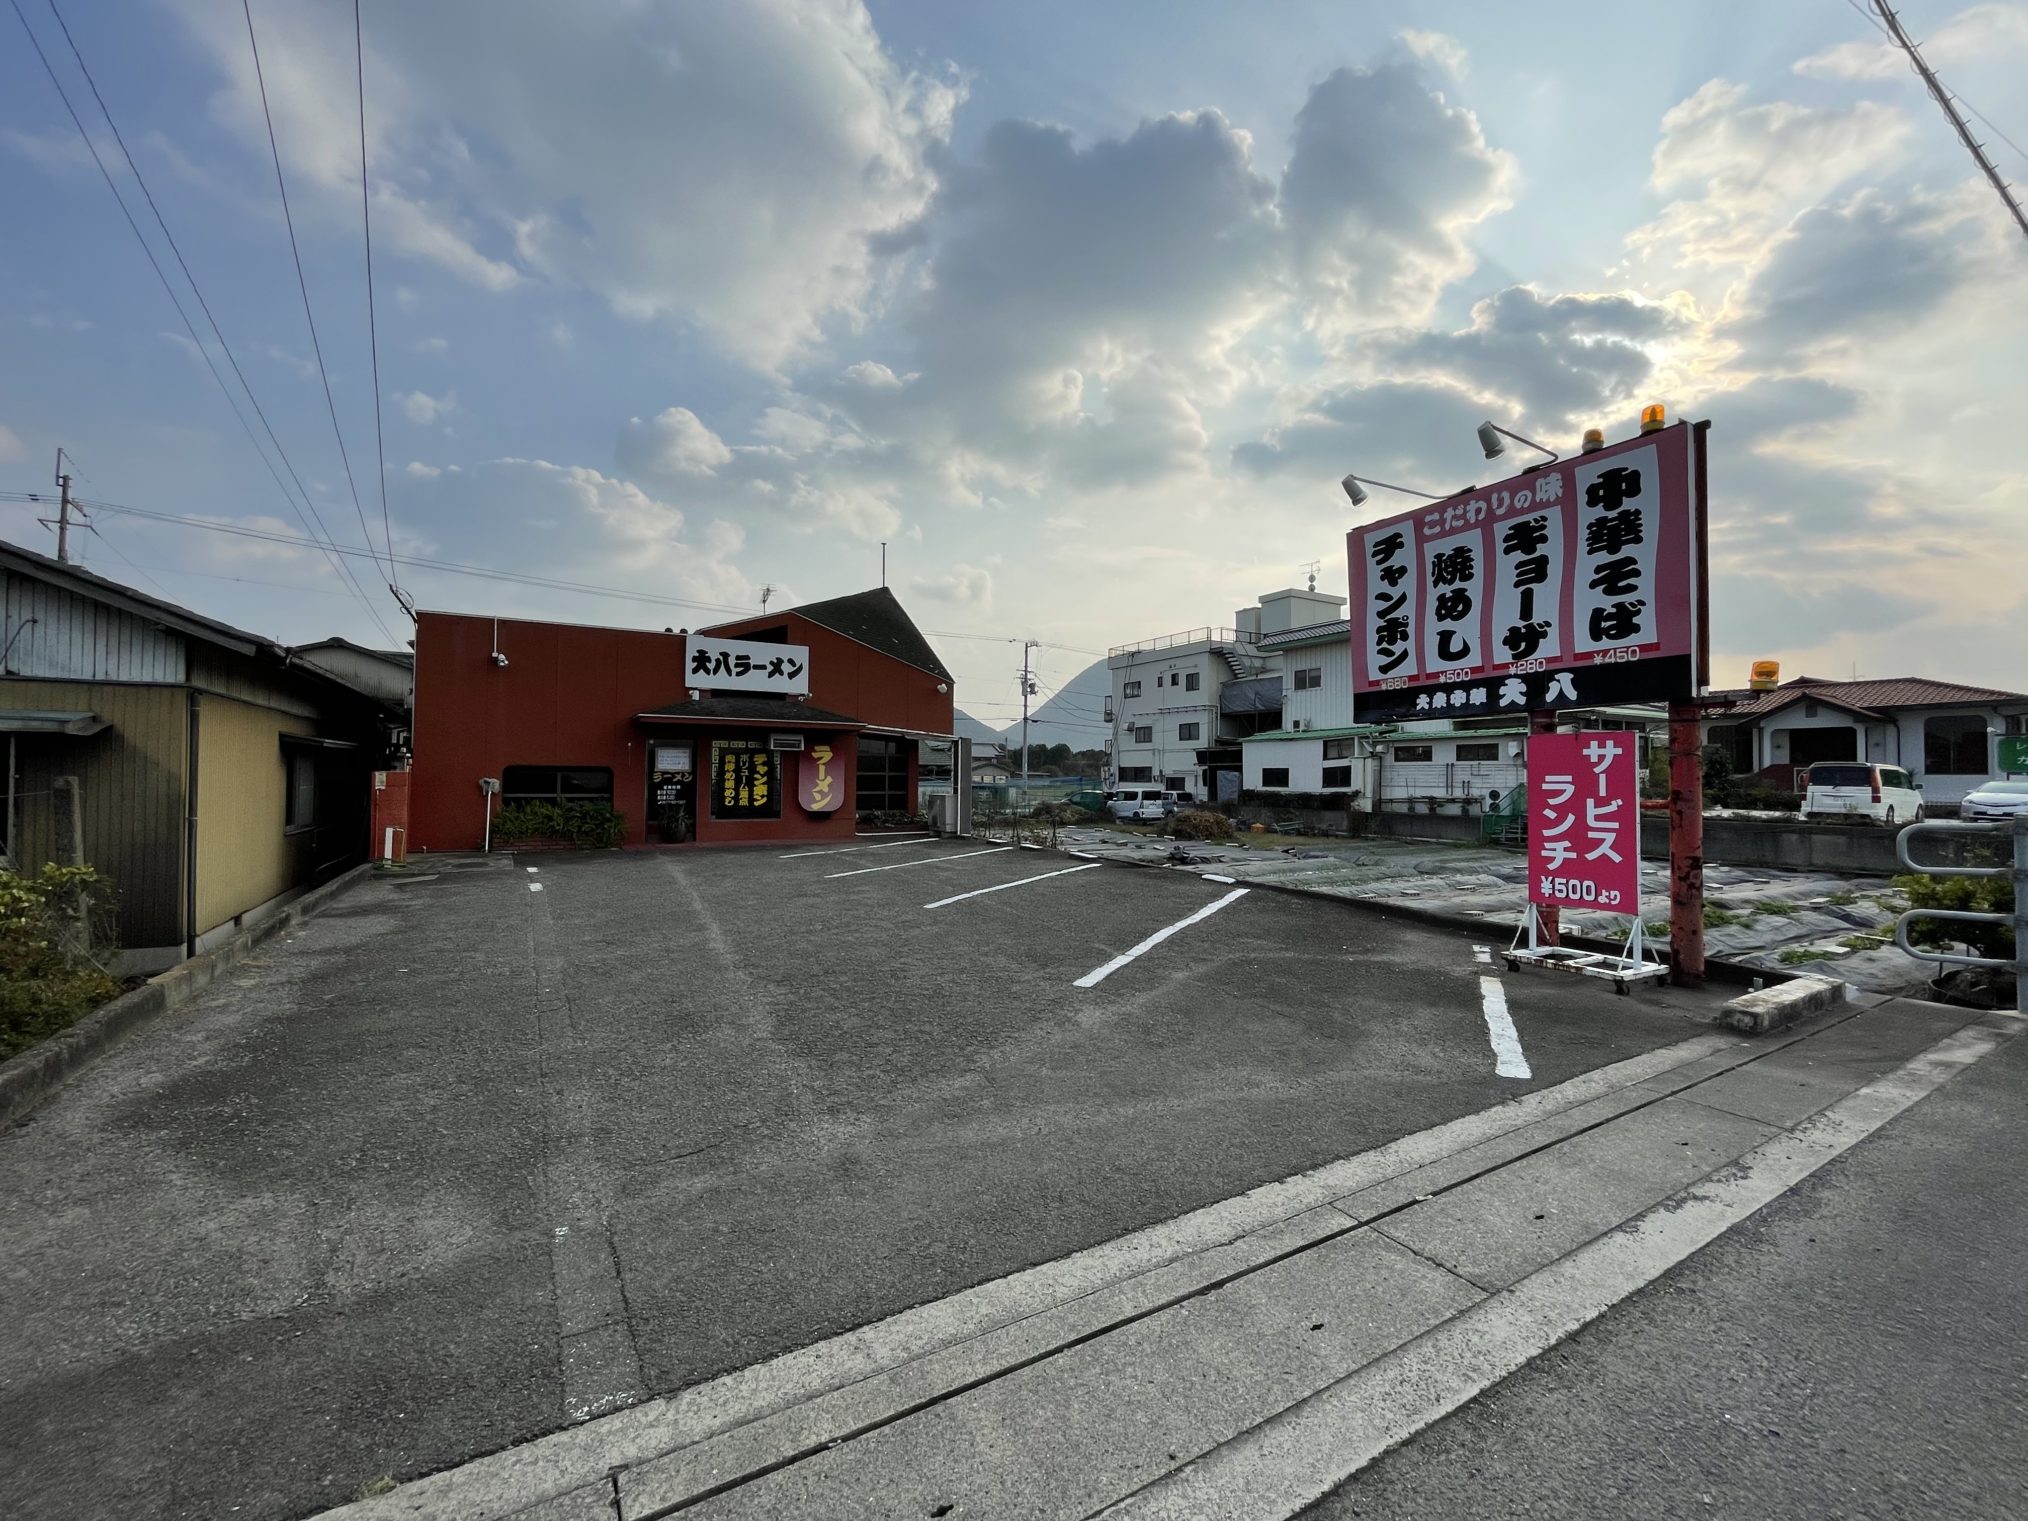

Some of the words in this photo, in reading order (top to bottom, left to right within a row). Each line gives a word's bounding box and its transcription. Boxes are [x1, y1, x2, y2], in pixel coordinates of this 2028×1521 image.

[1423, 472, 1564, 535] こだわりの味
[1584, 466, 1647, 643] 中華そば
[1371, 532, 1409, 675] チャンポン
[1431, 545, 1475, 662] 焼めし
[1502, 515, 1552, 661] ギョーザ
[692, 649, 804, 680] 大八ラーメン
[1380, 676, 1409, 691] ¥680
[1439, 668, 1471, 684] ¥500
[1508, 658, 1547, 675] ¥280
[1593, 646, 1640, 665] ¥450
[1499, 672, 1578, 706] 大八
[653, 772, 693, 782] ラーメン
[753, 753, 768, 807] チャンポン
[811, 745, 833, 811] ラーメン
[1582, 740, 1623, 864] サービス
[1541, 775, 1577, 871] ランチ
